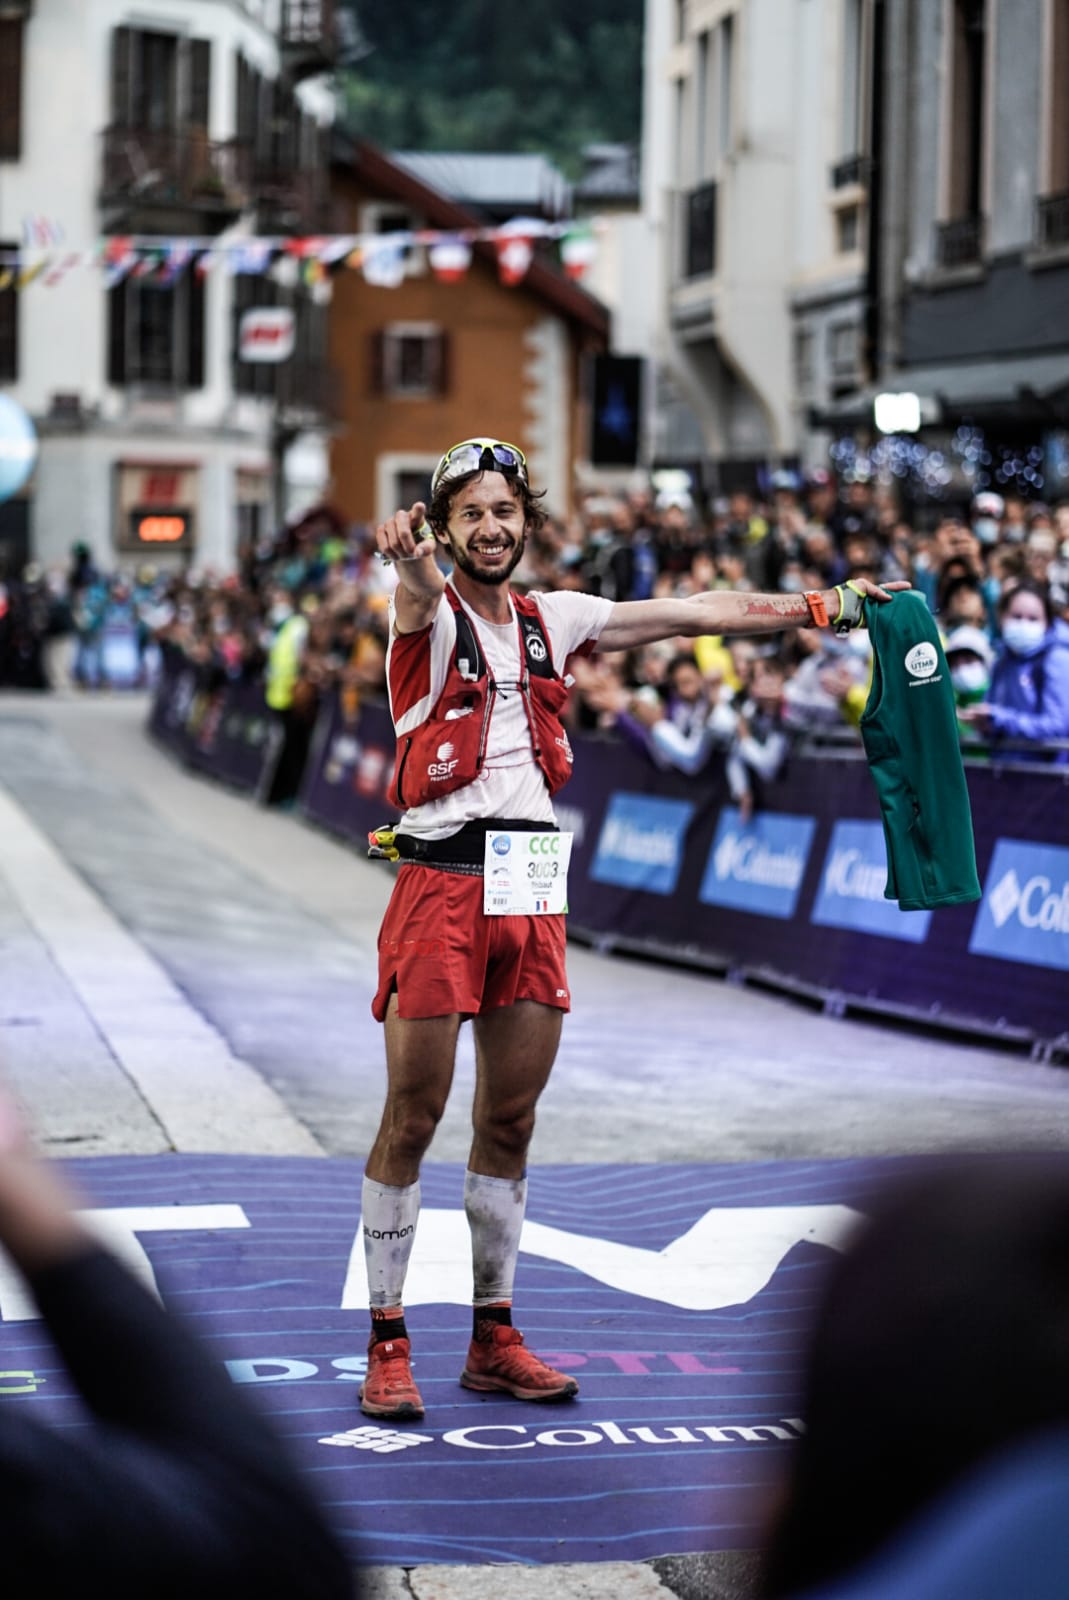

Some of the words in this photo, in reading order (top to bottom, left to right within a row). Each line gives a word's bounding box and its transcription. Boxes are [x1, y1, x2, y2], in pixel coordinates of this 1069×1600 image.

[911, 659, 934, 670] UTMB
[428, 759, 459, 776] GSF
[529, 835, 560, 855] CCC
[527, 861, 559, 879] 3003
